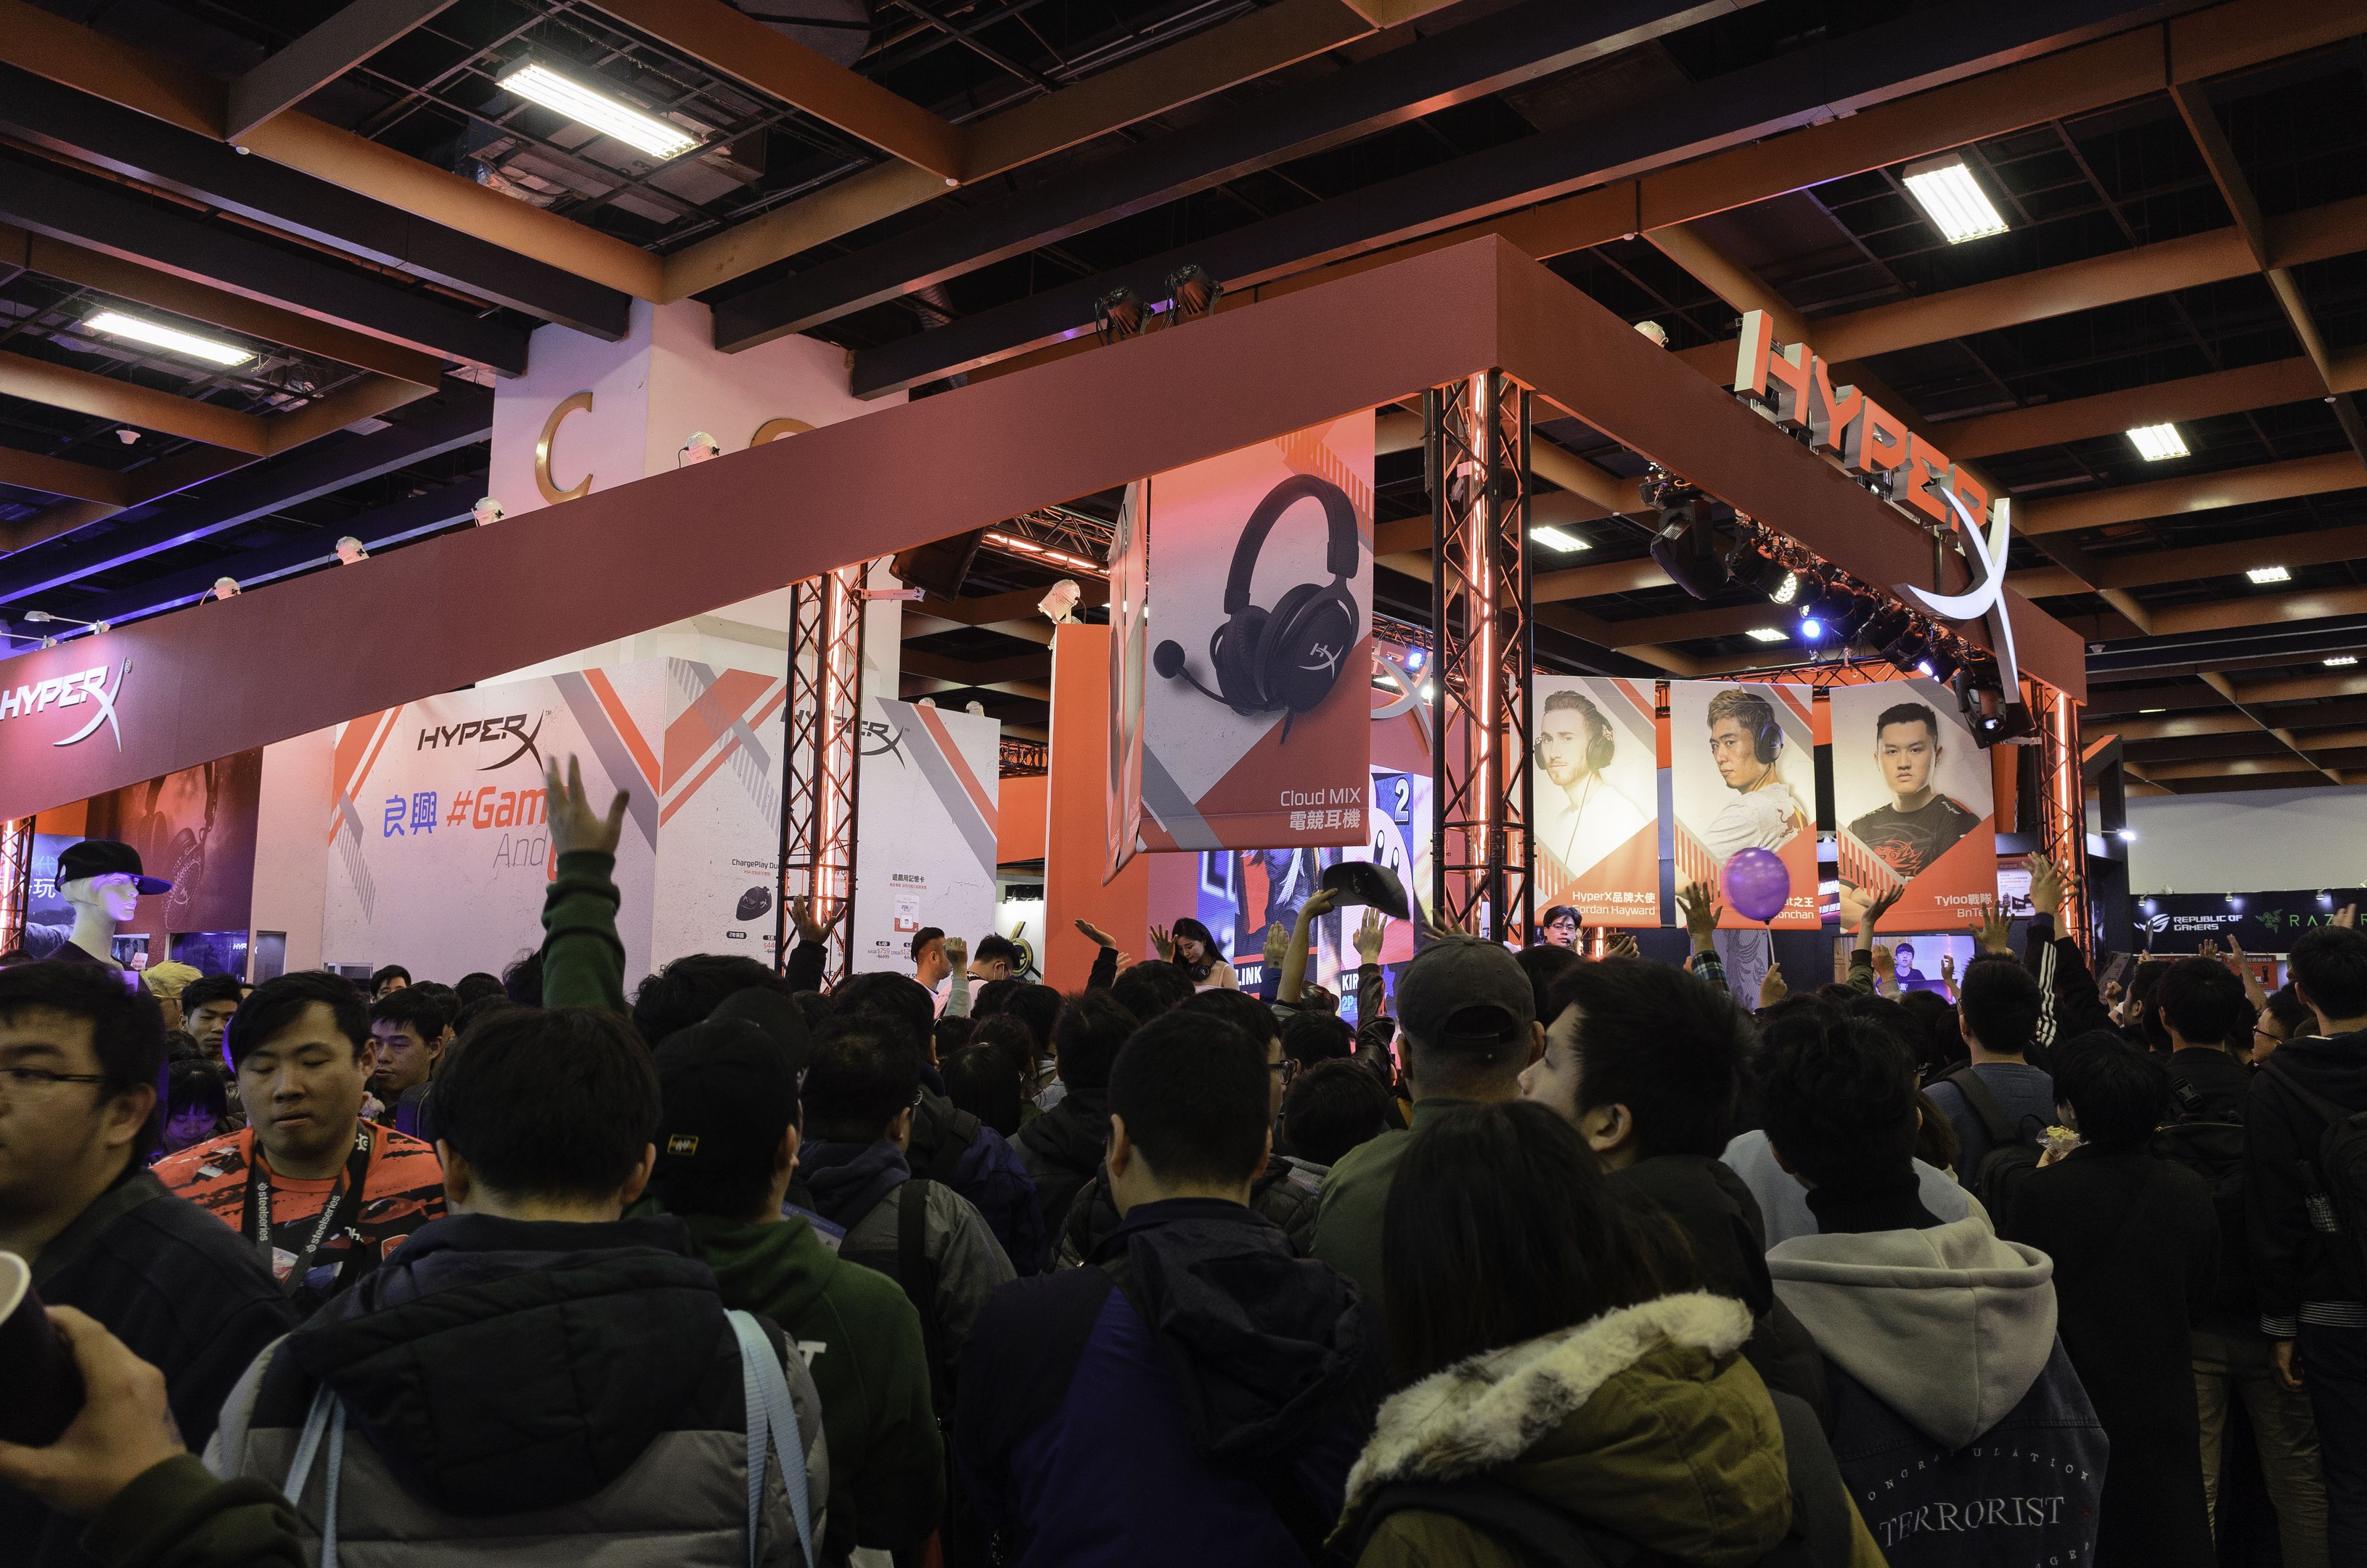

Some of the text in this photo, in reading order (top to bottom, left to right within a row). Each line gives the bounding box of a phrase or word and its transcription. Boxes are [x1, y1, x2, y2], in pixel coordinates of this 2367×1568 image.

[417, 708, 544, 776] HYPERX
[446, 785, 569, 830] #Gam
[1280, 787, 1362, 807] Cloud MIX
[1394, 777, 1410, 823] 2
[383, 791, 437, 838] 良興
[1290, 808, 1361, 831] 電競耳機
[493, 831, 548, 868] And
[732, 859, 769, 870] ChargePlay
[1572, 891, 1656, 904] HyperX品牌大使
[1611, 906, 1656, 916] Hayward
[1783, 896, 1814, 907] at之王
[2289, 913, 2367, 927] RAZR
[1235, 965, 1262, 986] LINK
[258, 1191, 269, 1242] steelseries
[311, 1194, 341, 1245] steelseries
[1879, 1495, 2064, 1548] TERRORIST
